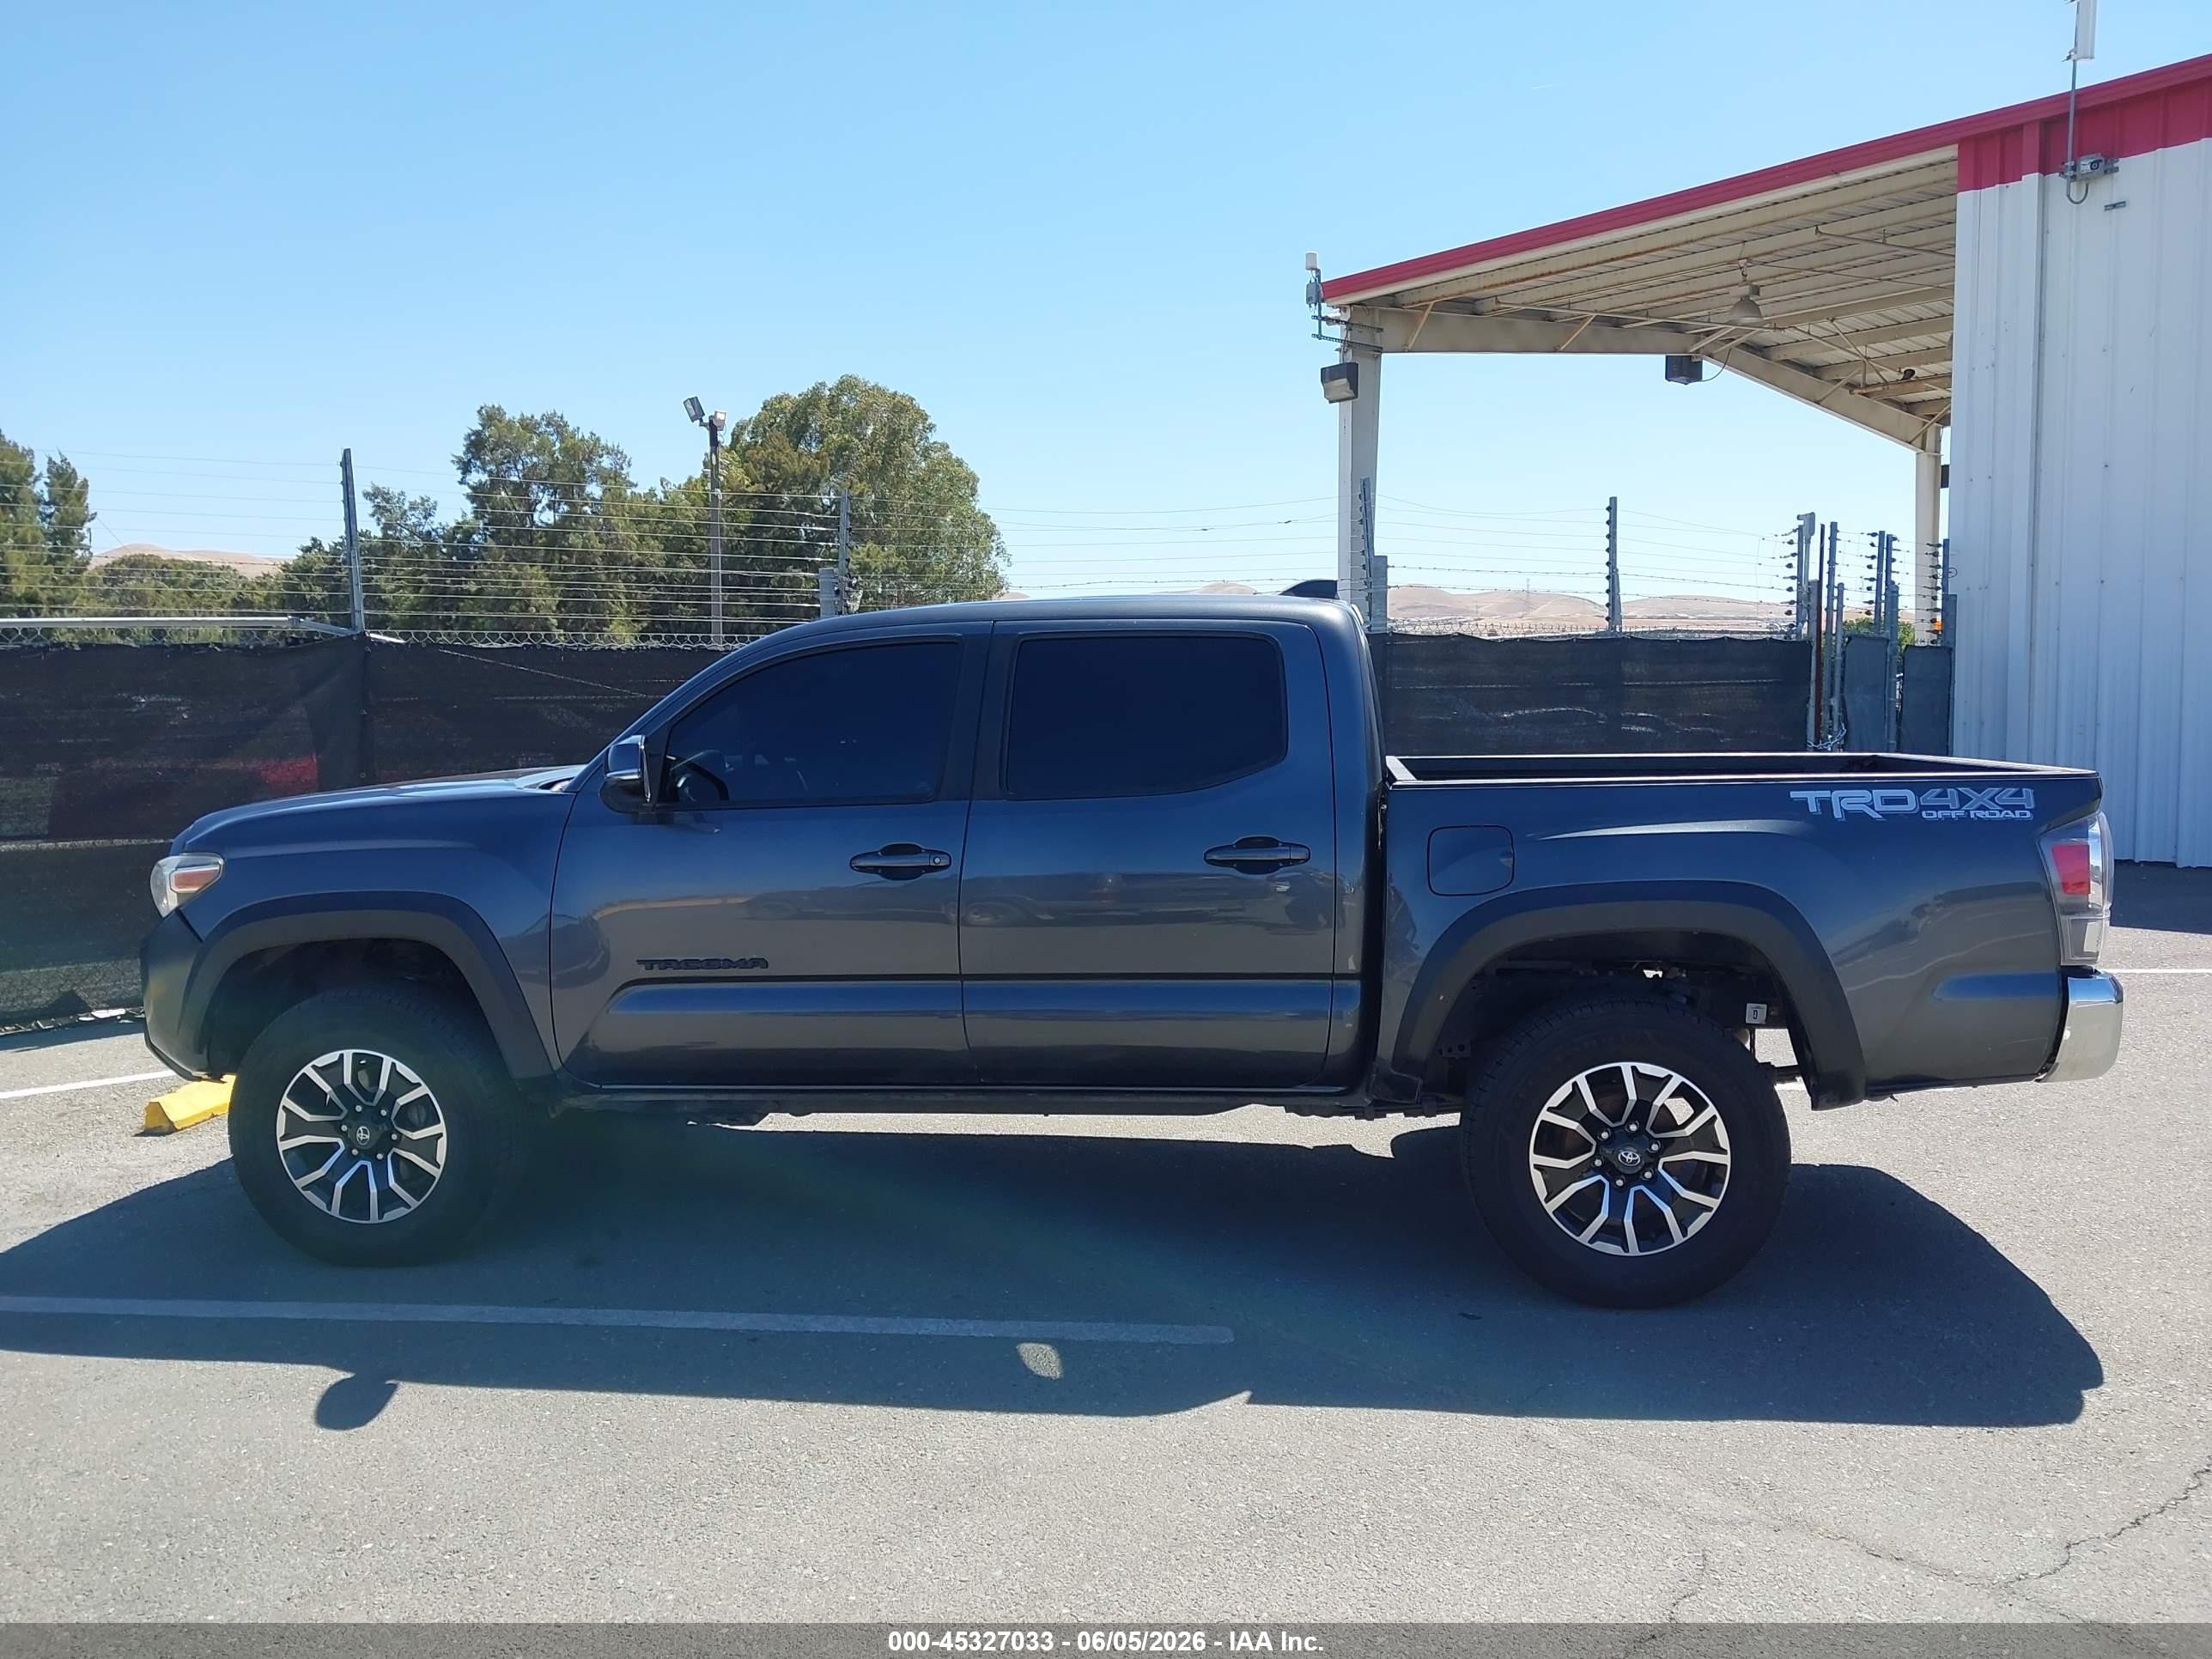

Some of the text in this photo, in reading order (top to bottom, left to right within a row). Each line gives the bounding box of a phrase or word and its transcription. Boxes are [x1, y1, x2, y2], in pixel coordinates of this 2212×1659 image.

[1790, 787, 2036, 820] TRD 4X4
[1922, 810, 2033, 820] OFF ROAD
[635, 957, 769, 970] TACOMA
